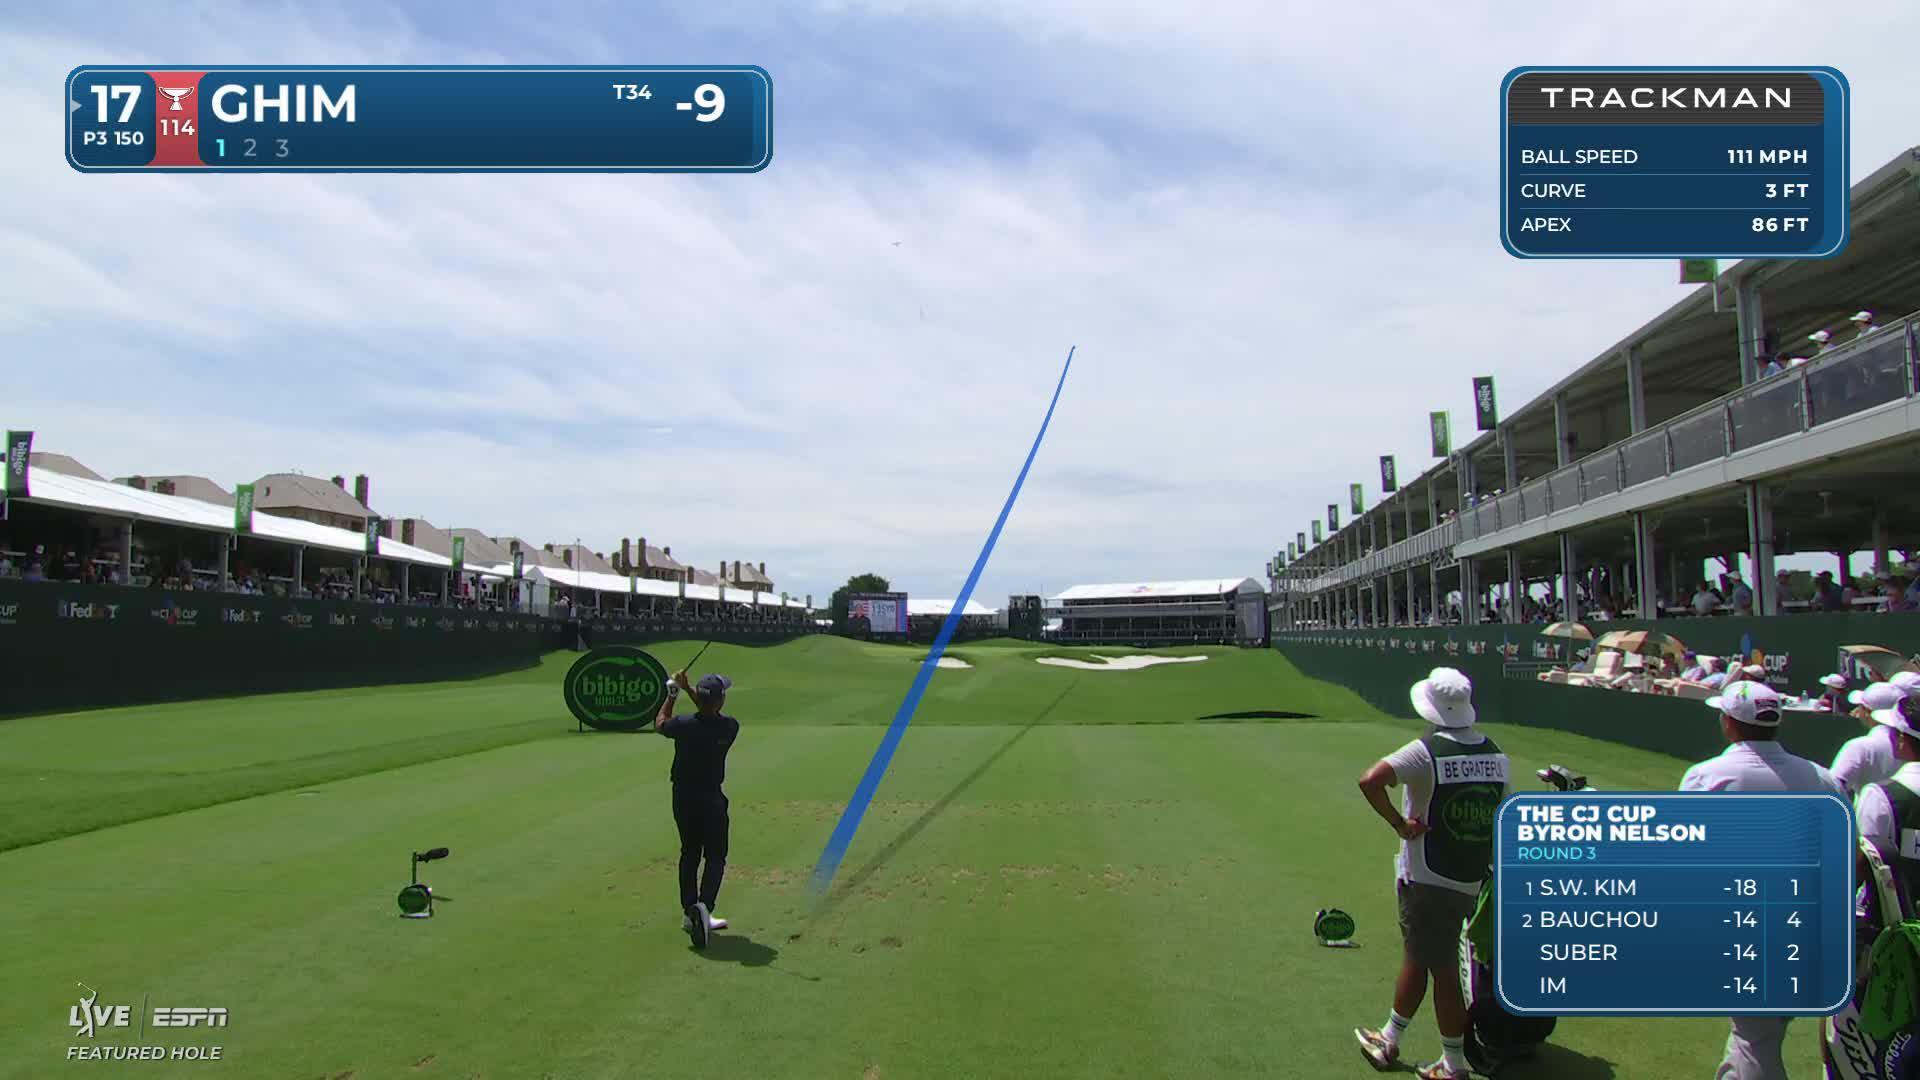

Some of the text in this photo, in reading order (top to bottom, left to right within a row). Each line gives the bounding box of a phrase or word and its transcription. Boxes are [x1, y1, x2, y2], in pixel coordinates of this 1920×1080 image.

[1762, 655, 1787, 672] CUP
[582, 674, 656, 702] bibigo
[1444, 761, 1504, 779] BE GRATEFUL
